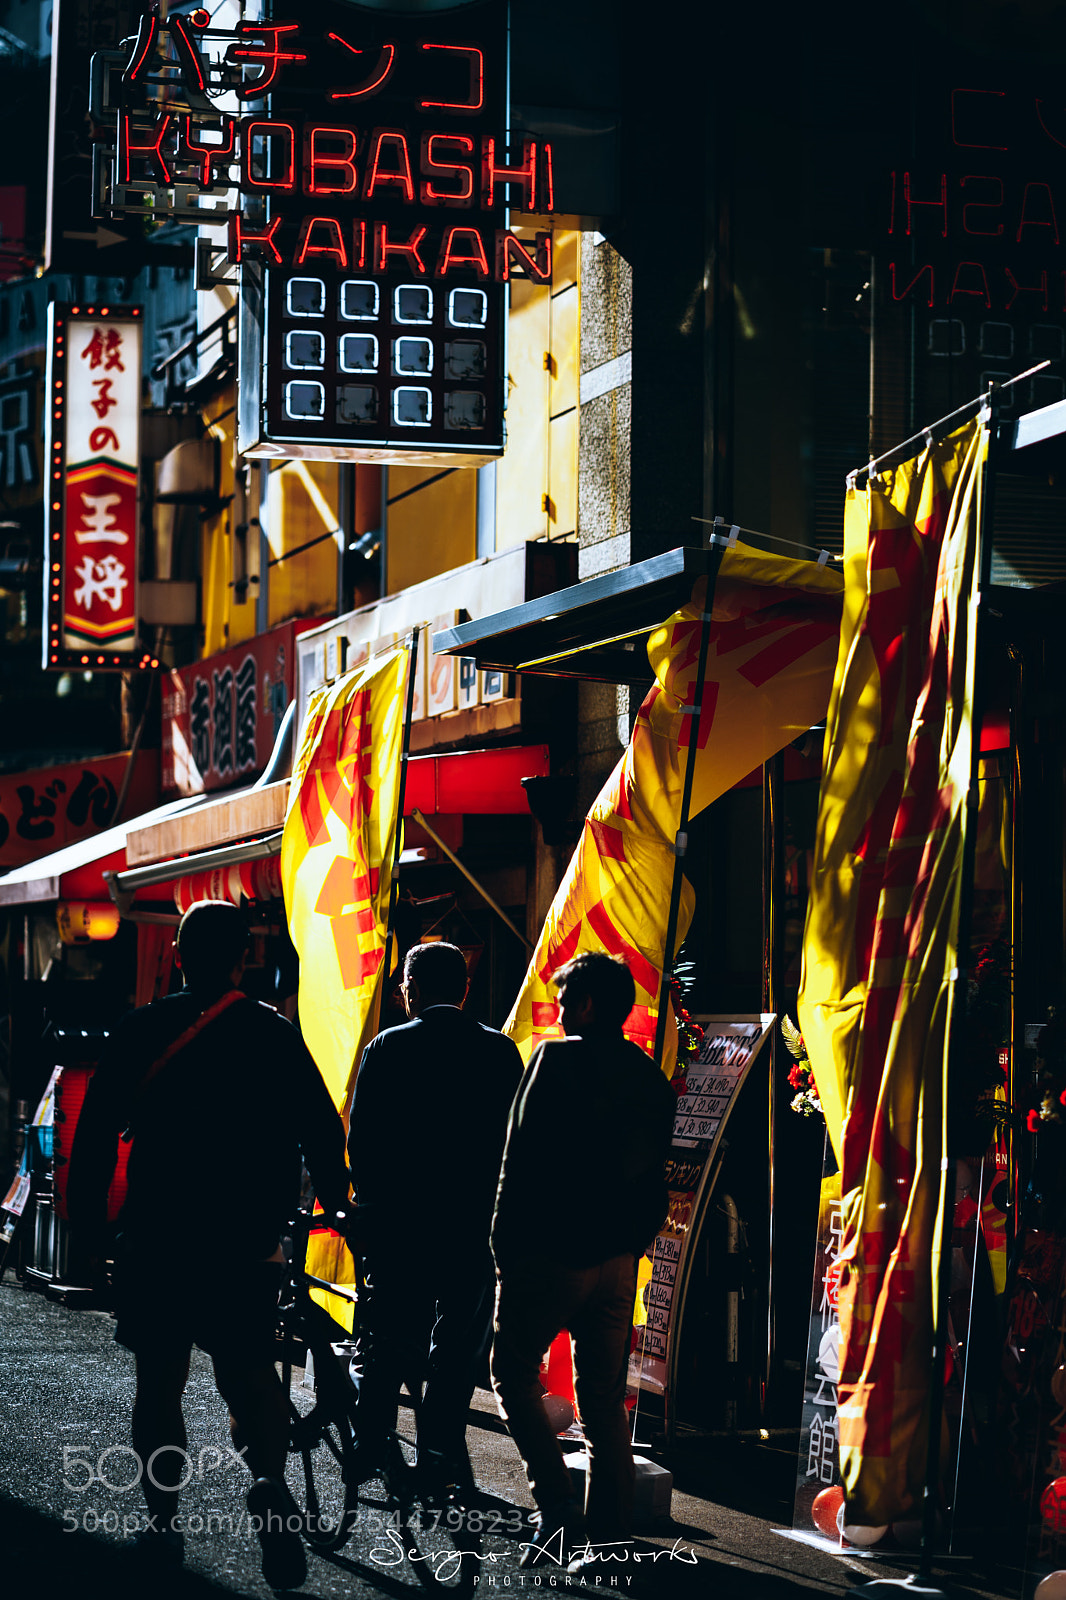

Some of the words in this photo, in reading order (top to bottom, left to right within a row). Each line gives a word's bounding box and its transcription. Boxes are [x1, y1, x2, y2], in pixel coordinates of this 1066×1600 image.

[121, 8, 485, 110] パチンコ
[118, 112, 554, 213] KYOBASHI
[230, 213, 553, 284] KAIKAN
[73, 327, 130, 612] 餃子の王将
[0, 769, 119, 847] どん
